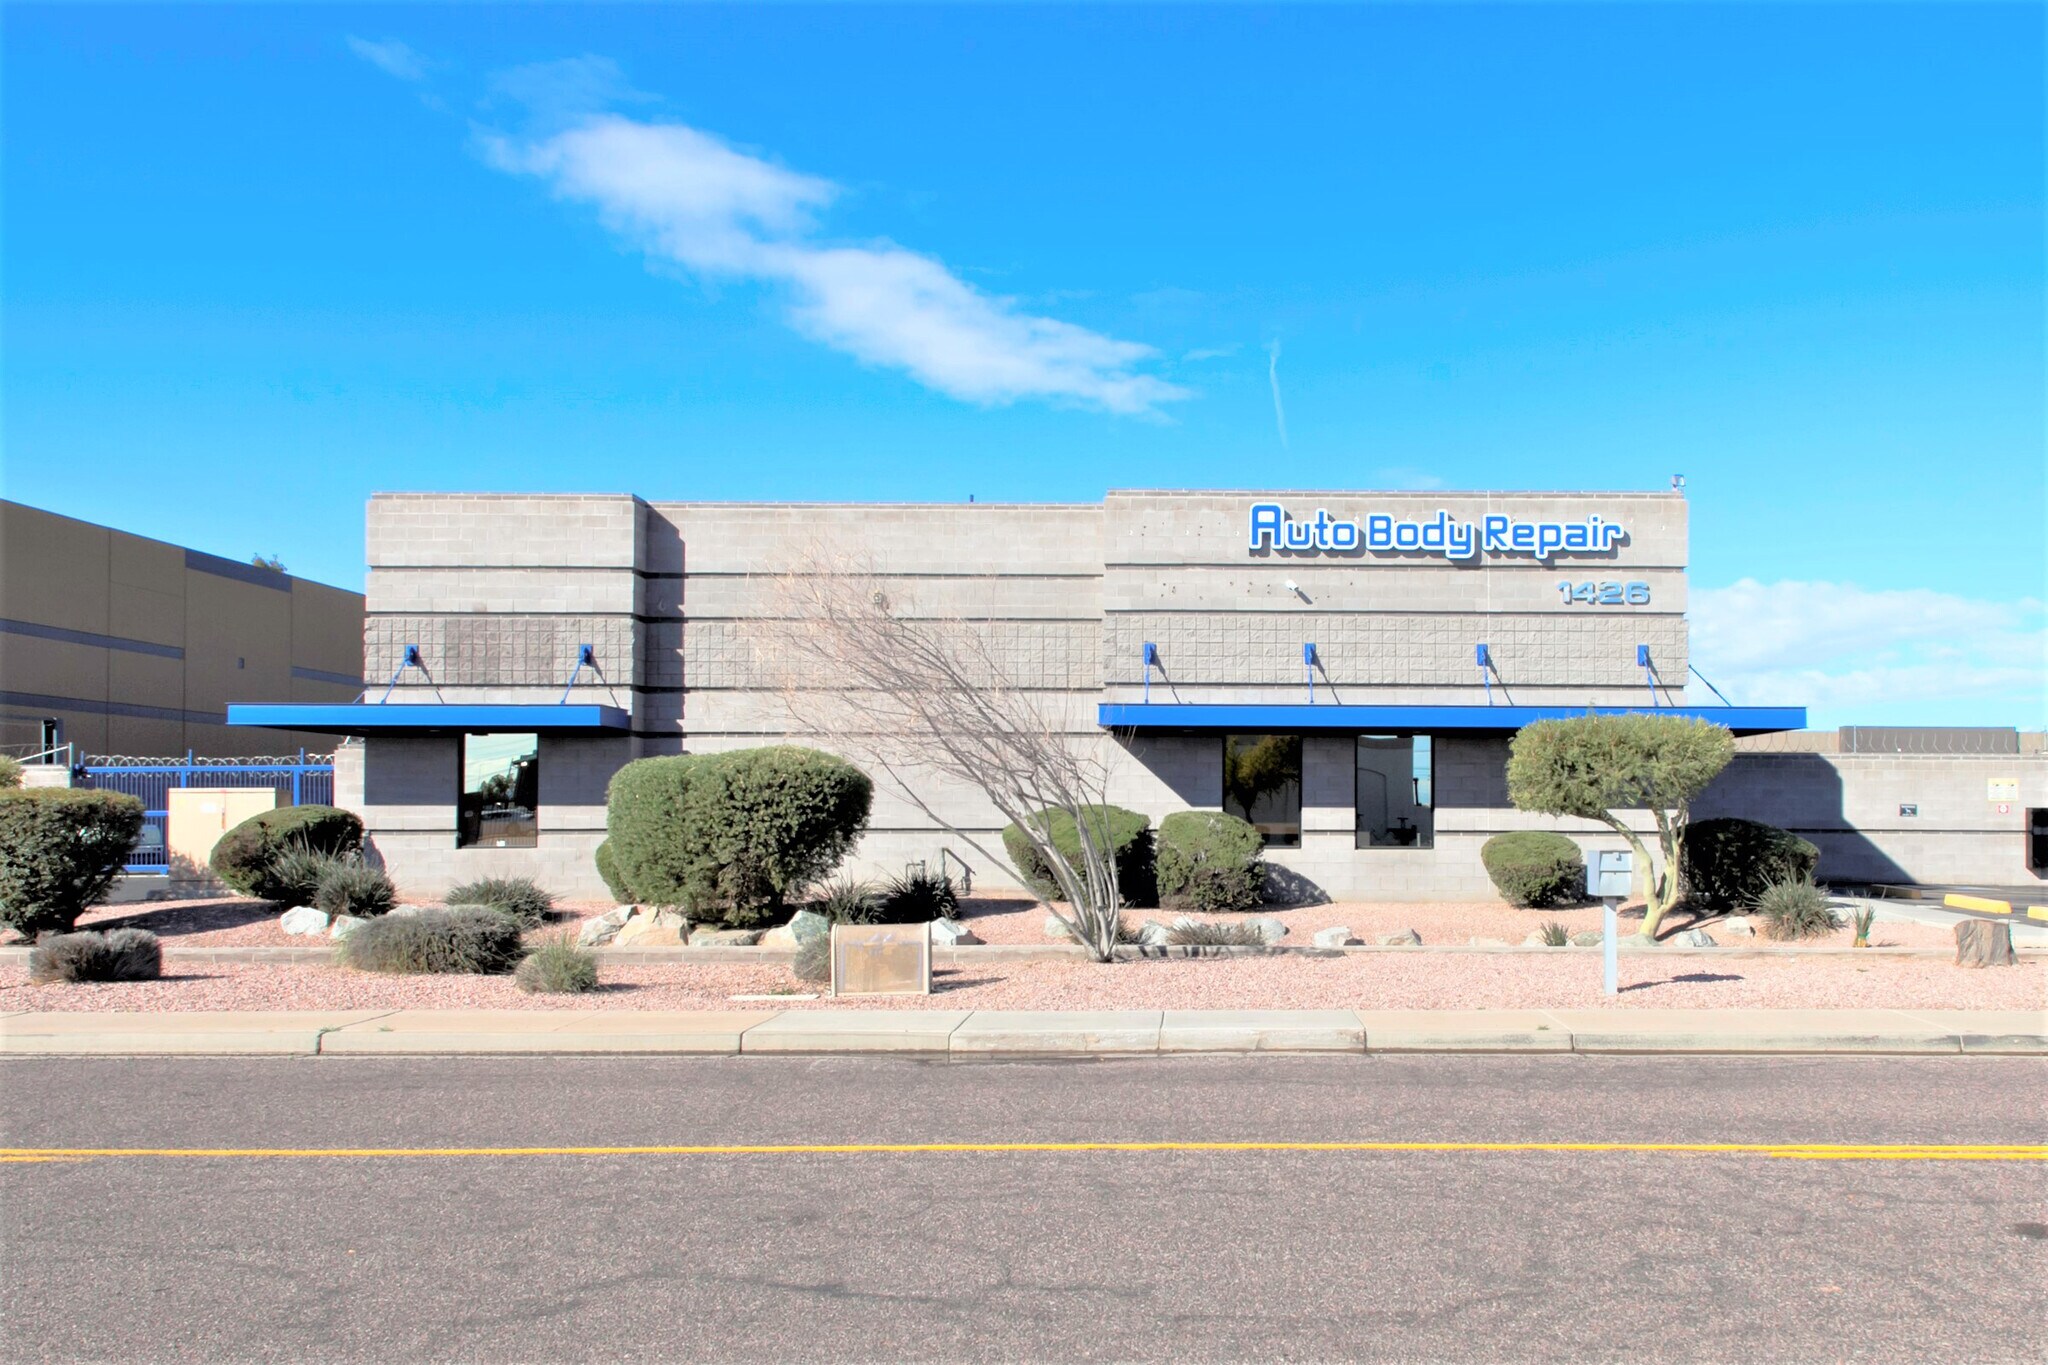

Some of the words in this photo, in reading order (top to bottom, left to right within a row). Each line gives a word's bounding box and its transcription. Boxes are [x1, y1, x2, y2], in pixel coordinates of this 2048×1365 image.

[1250, 503, 1358, 548] Auto
[1367, 509, 1474, 557] Body
[1483, 514, 1623, 558] Repair
[1556, 581, 1650, 604] 1426
